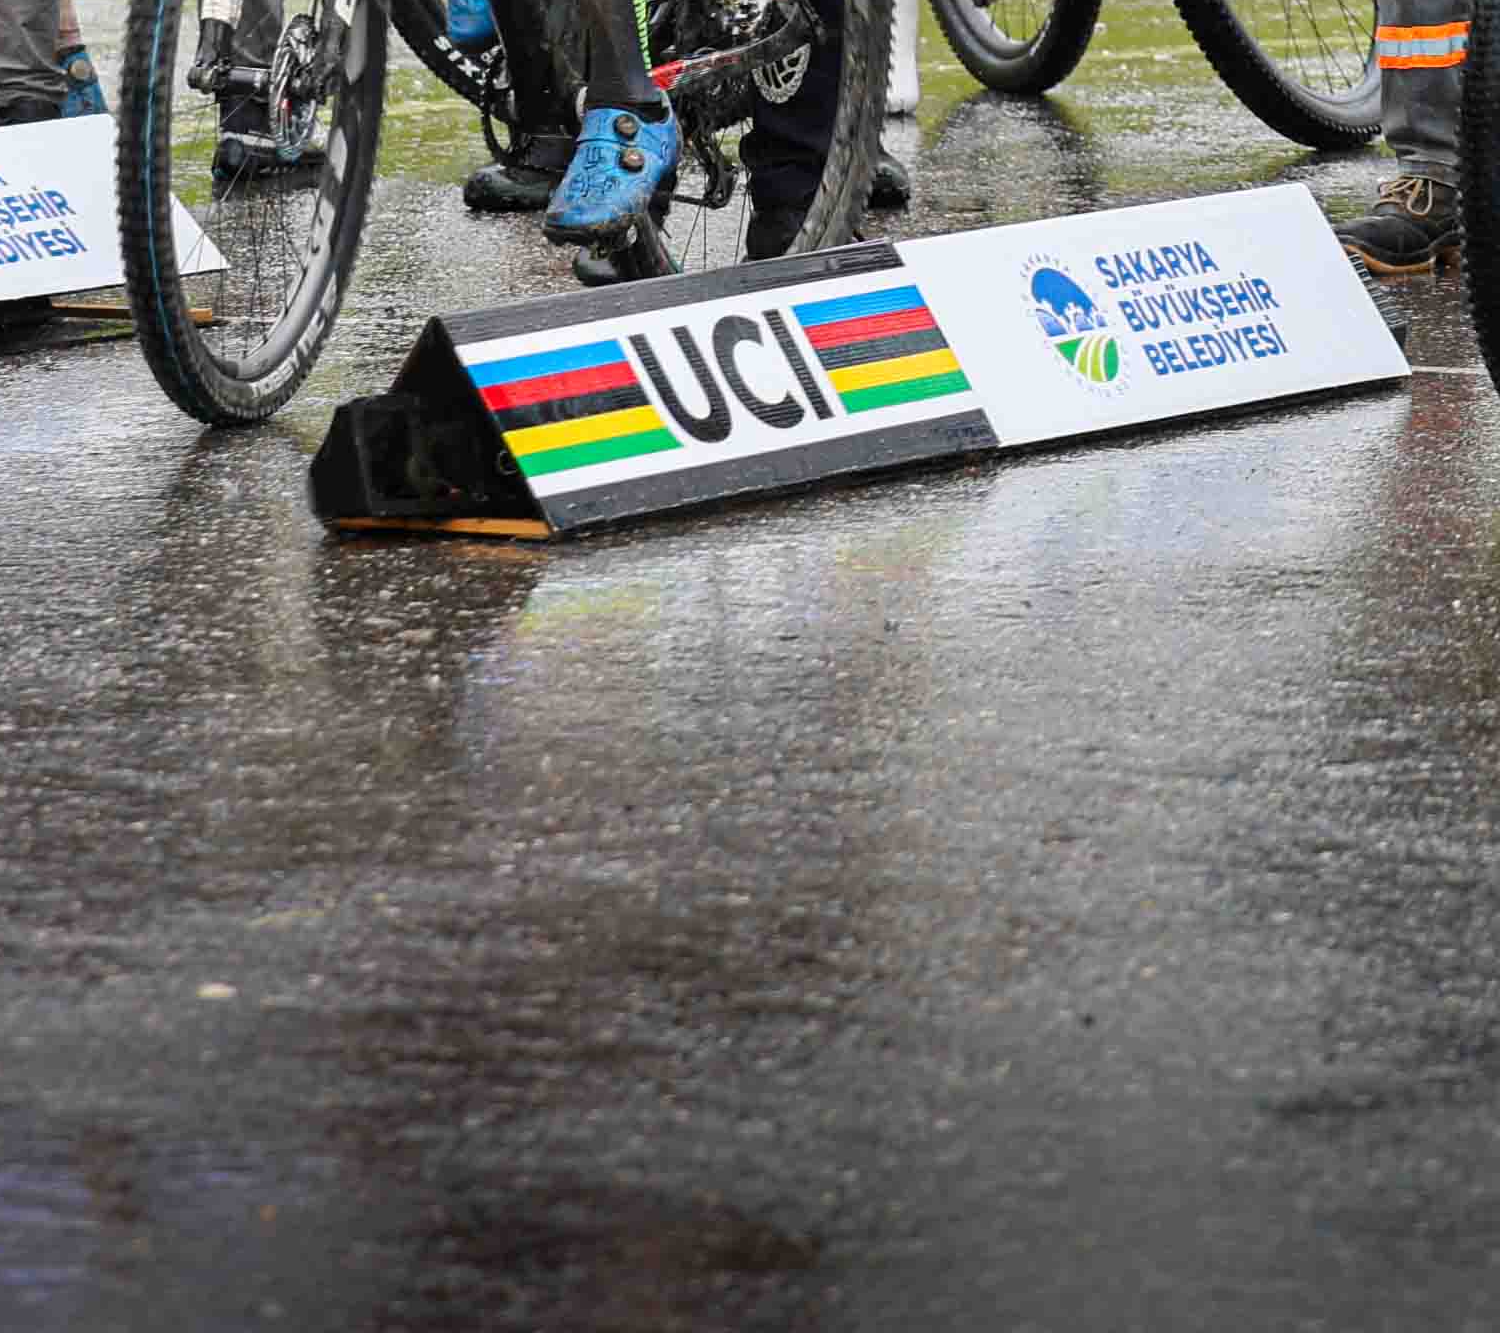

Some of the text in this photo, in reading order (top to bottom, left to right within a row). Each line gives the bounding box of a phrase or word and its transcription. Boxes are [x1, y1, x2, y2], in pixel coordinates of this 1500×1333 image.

[1095, 240, 1220, 289] SAKARYA
[1118, 271, 1280, 333] BÜYÜKŞEHİR
[629, 306, 834, 444] UCI
[1142, 314, 1288, 376] BELEDİYESİ
